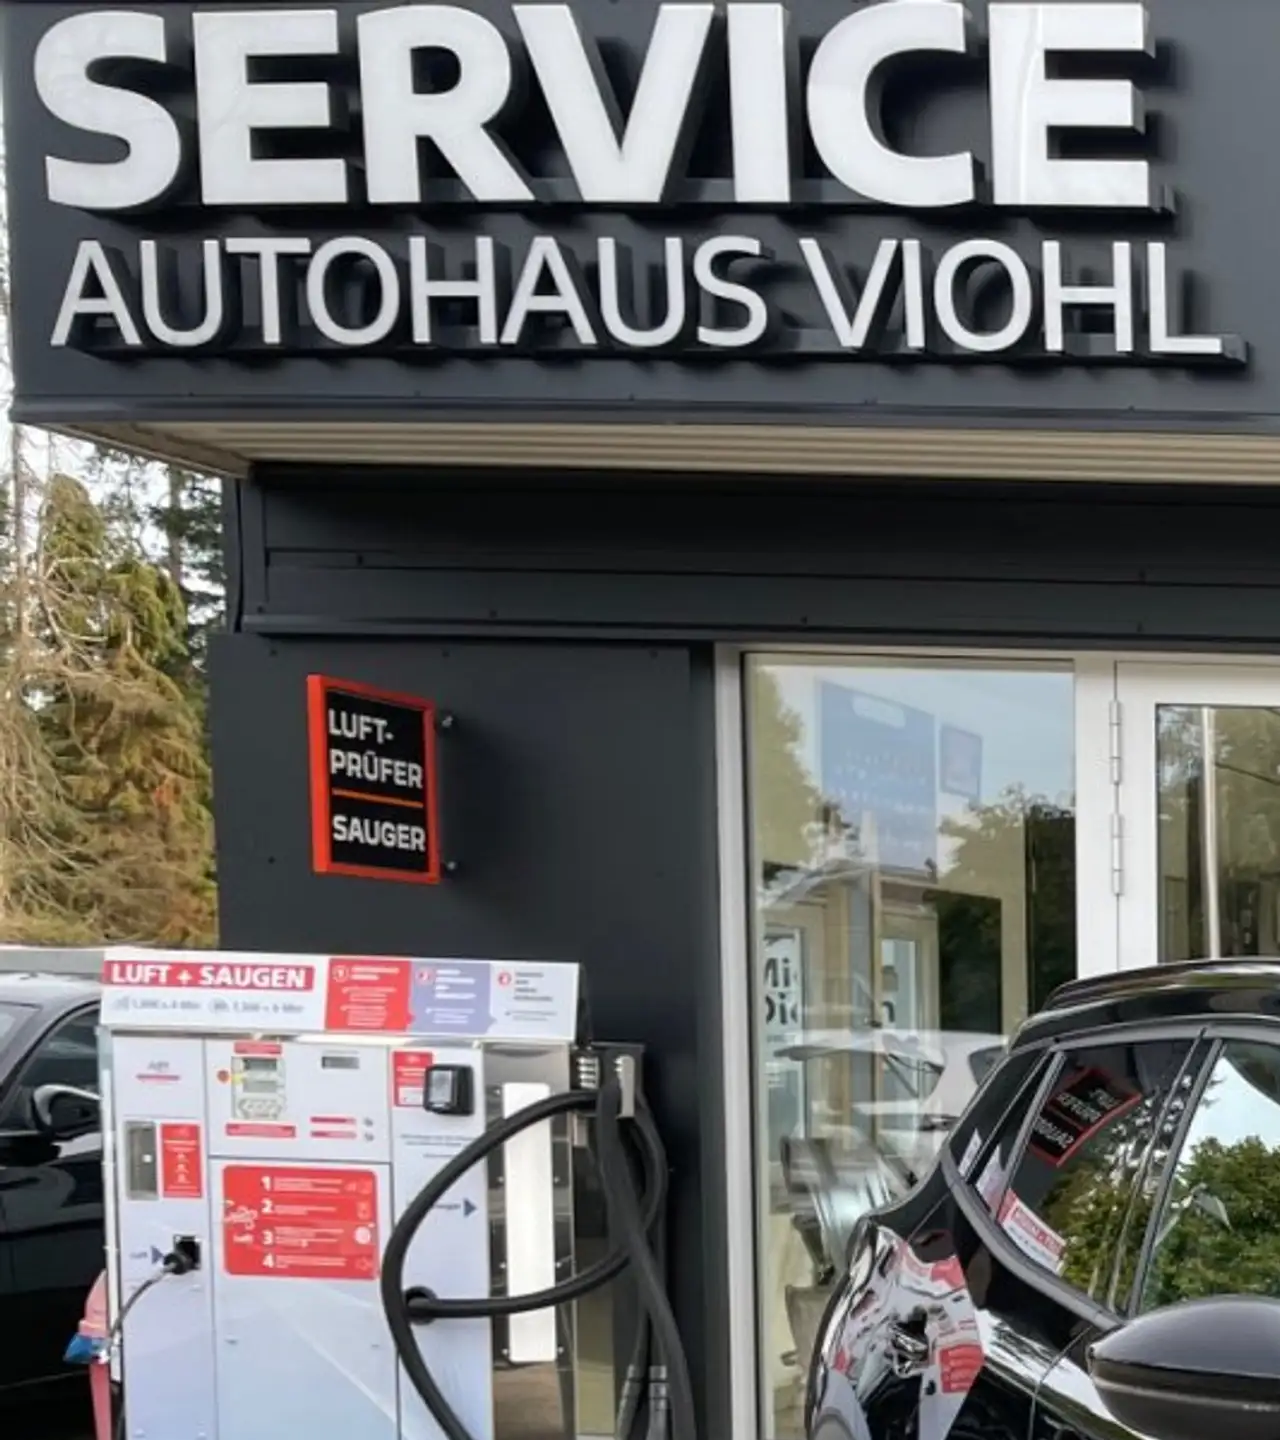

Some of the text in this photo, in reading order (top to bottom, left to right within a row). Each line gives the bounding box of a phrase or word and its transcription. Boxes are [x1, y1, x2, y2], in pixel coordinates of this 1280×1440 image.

[33, 0, 1152, 208] SERVICE
[50, 236, 1222, 355] AUTOHAUS VIOHL
[328, 708, 394, 744] LUFT-
[329, 749, 424, 789] PRÜFER
[332, 814, 426, 852] SAUGER
[111, 963, 171, 984] LUFT
[199, 966, 306, 988] SAUGEN
[261, 1176, 271, 1191] 1
[261, 1198, 273, 1213] 2
[262, 1229, 274, 1245] 3
[262, 1254, 274, 1268] 4
